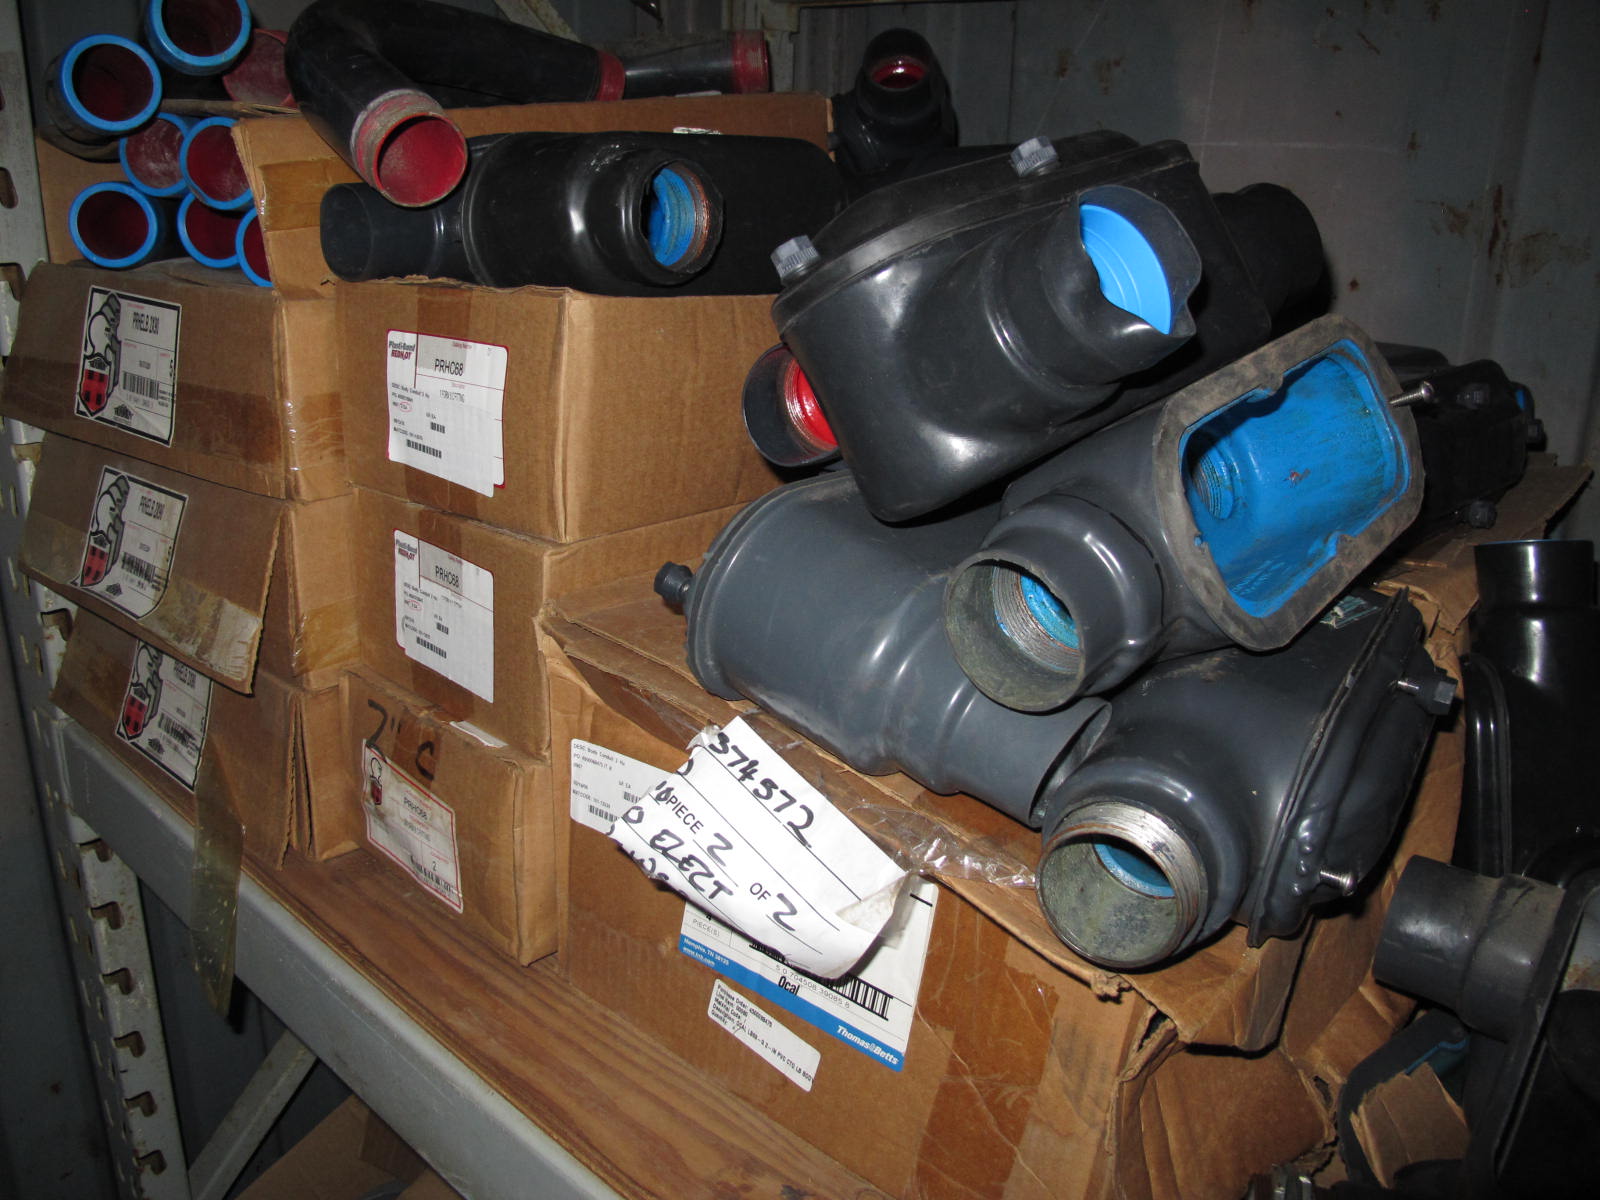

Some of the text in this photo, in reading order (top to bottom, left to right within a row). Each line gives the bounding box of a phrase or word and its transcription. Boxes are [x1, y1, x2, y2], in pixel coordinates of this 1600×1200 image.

[434, 357, 464, 377] PRHC68
[666, 794, 704, 835] PIECE
[749, 881, 771, 901] OF
[692, 918, 720, 937] PIECE(S)
[778, 975, 800, 996] Ocal
[836, 1025, 899, 1065] Thomas&Betts
